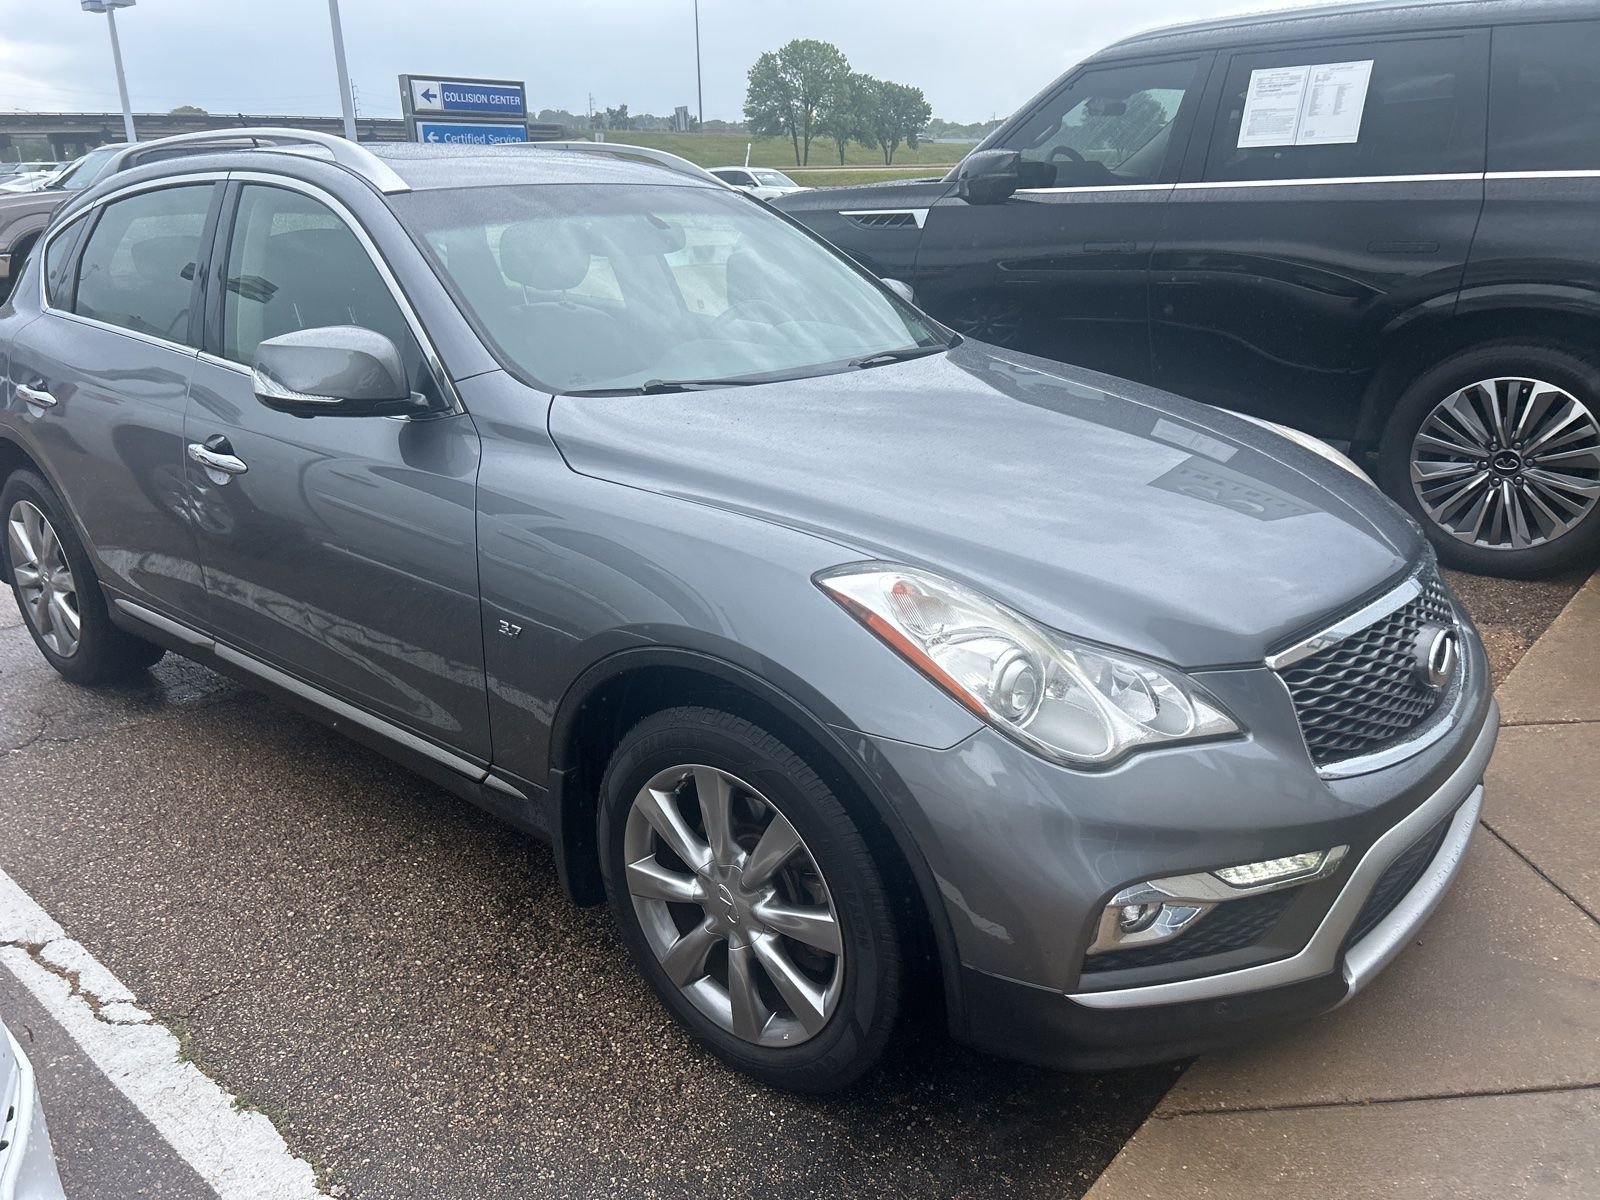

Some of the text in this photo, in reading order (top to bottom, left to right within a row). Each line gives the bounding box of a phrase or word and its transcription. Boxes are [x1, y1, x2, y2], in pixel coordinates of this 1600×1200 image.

[444, 92, 521, 105] COLLISION CENTER
[444, 133, 486, 144] Certified
[498, 619, 522, 637] 3.7
